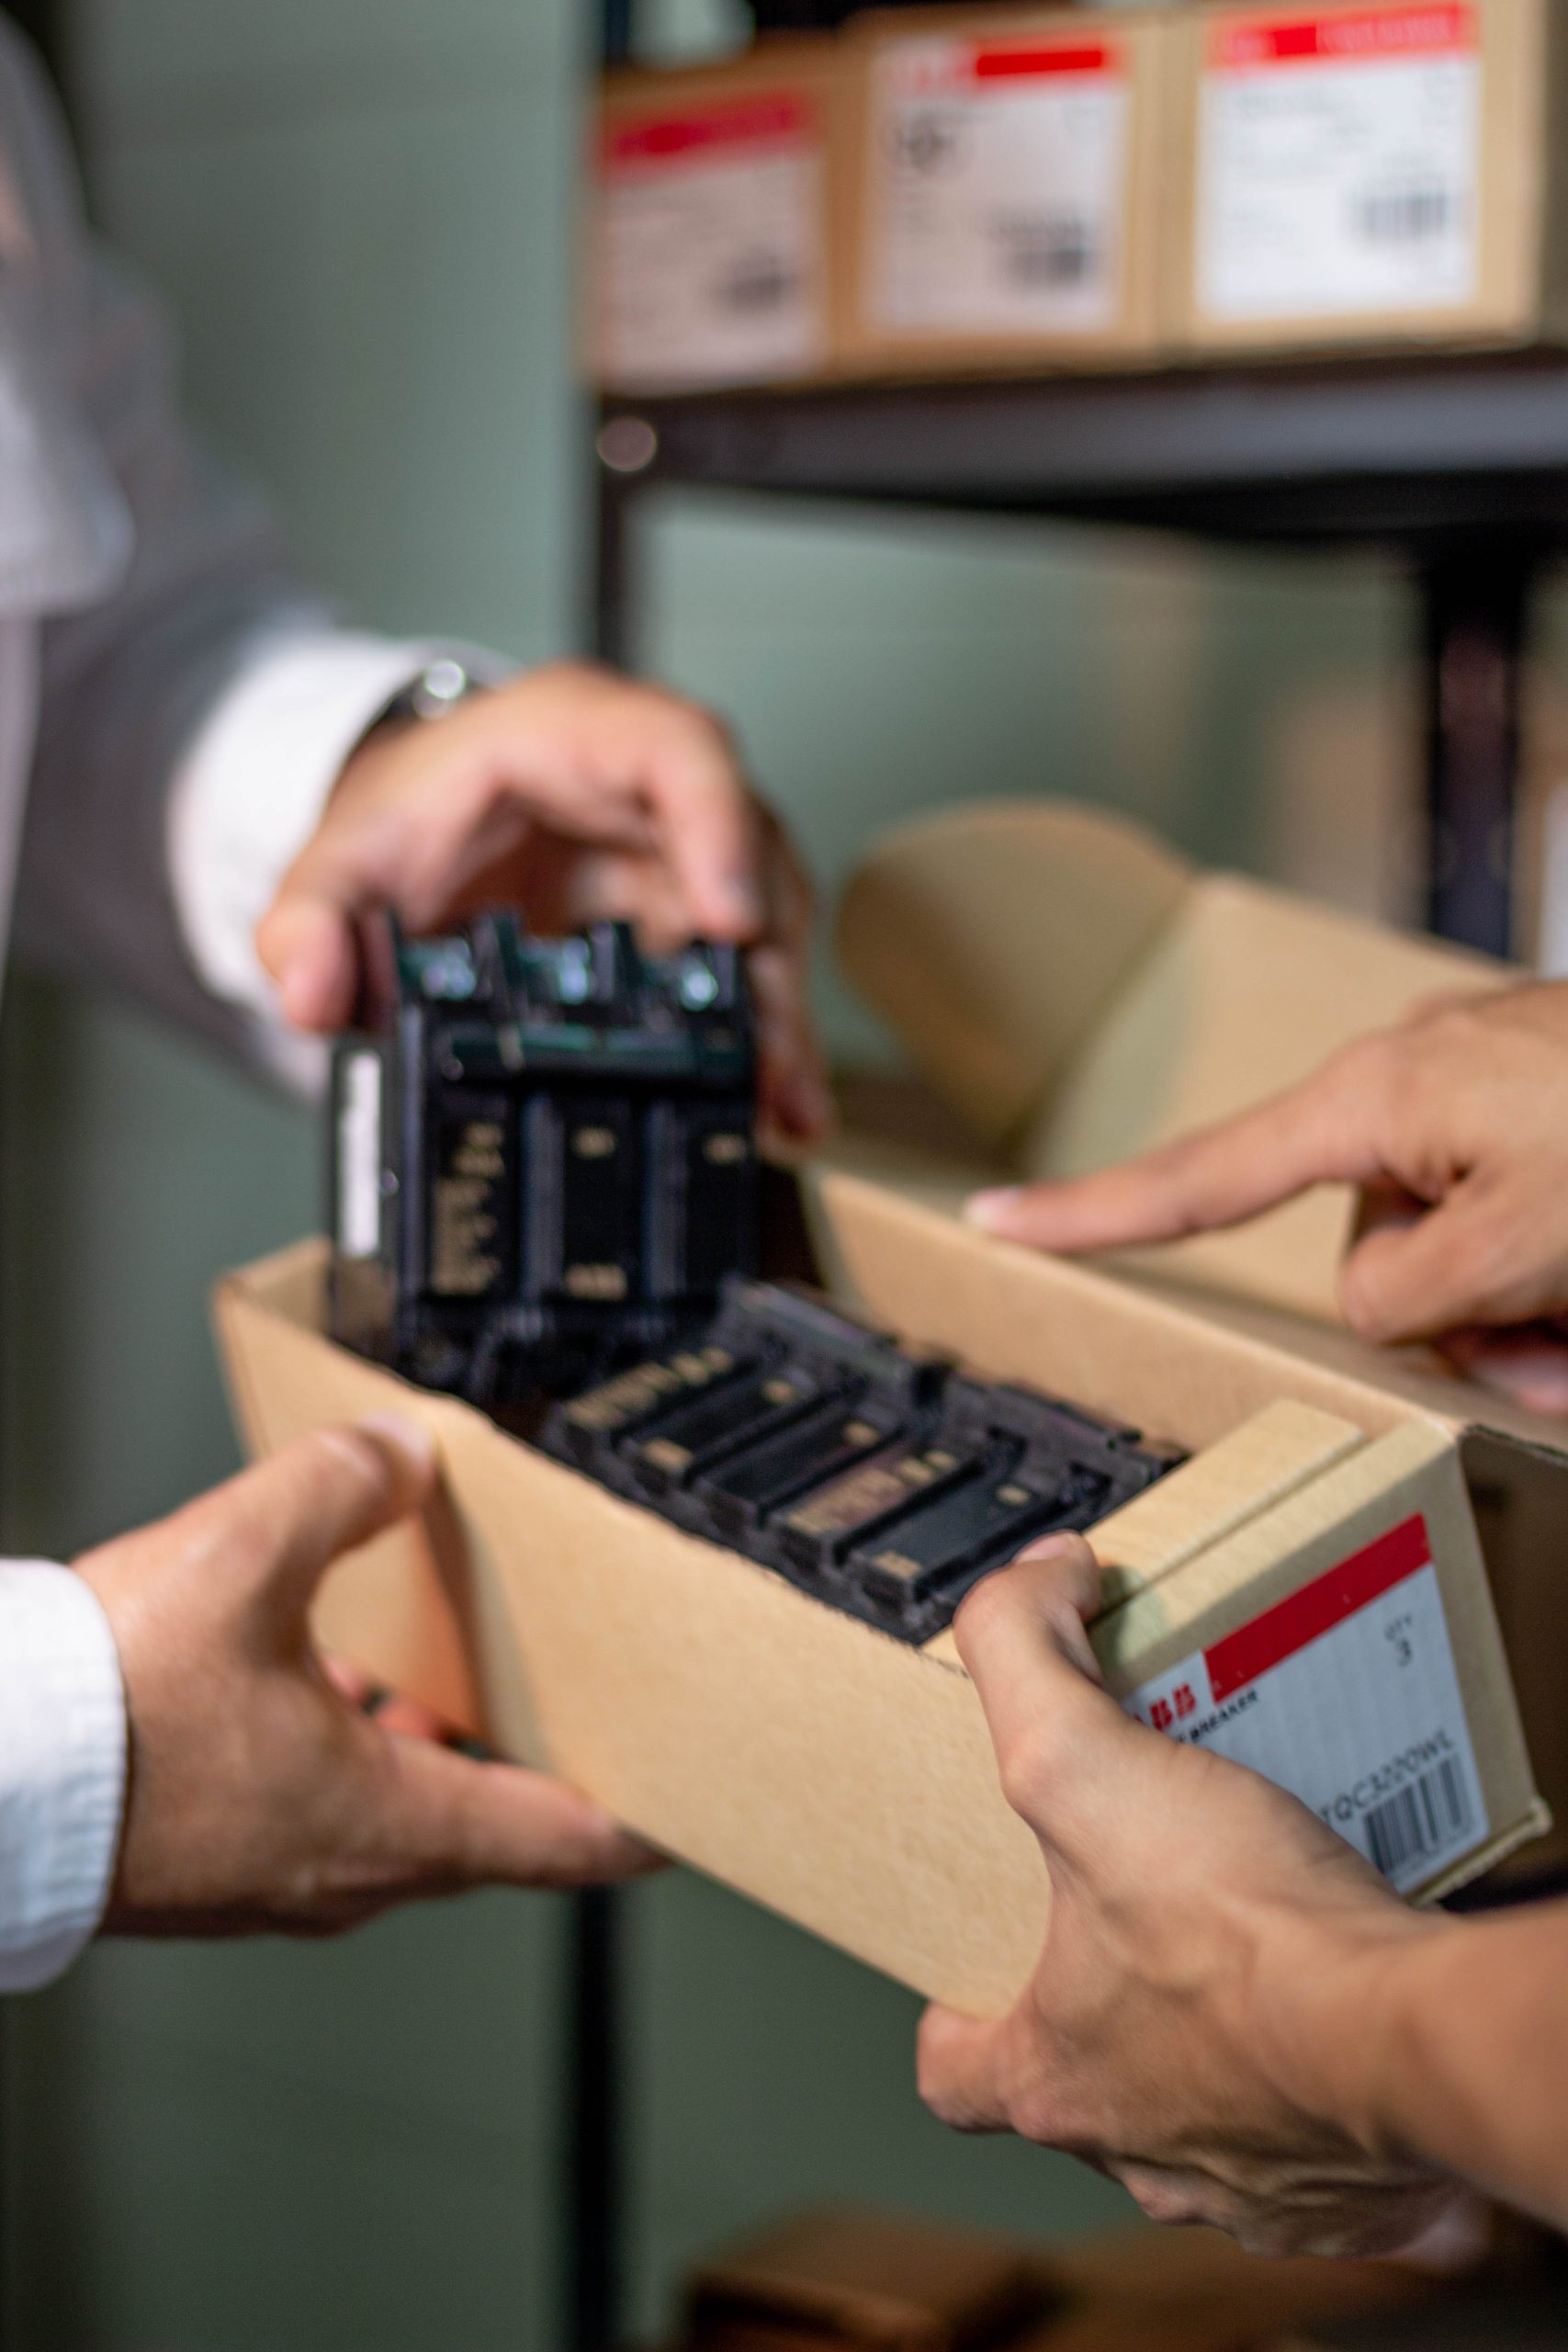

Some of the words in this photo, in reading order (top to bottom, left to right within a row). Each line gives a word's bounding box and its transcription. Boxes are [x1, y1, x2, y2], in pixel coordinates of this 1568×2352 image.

[1395, 1639, 1413, 1668] 3
[1133, 1681, 1196, 1733] BB
[1190, 1689, 1258, 1744] BREAKER
